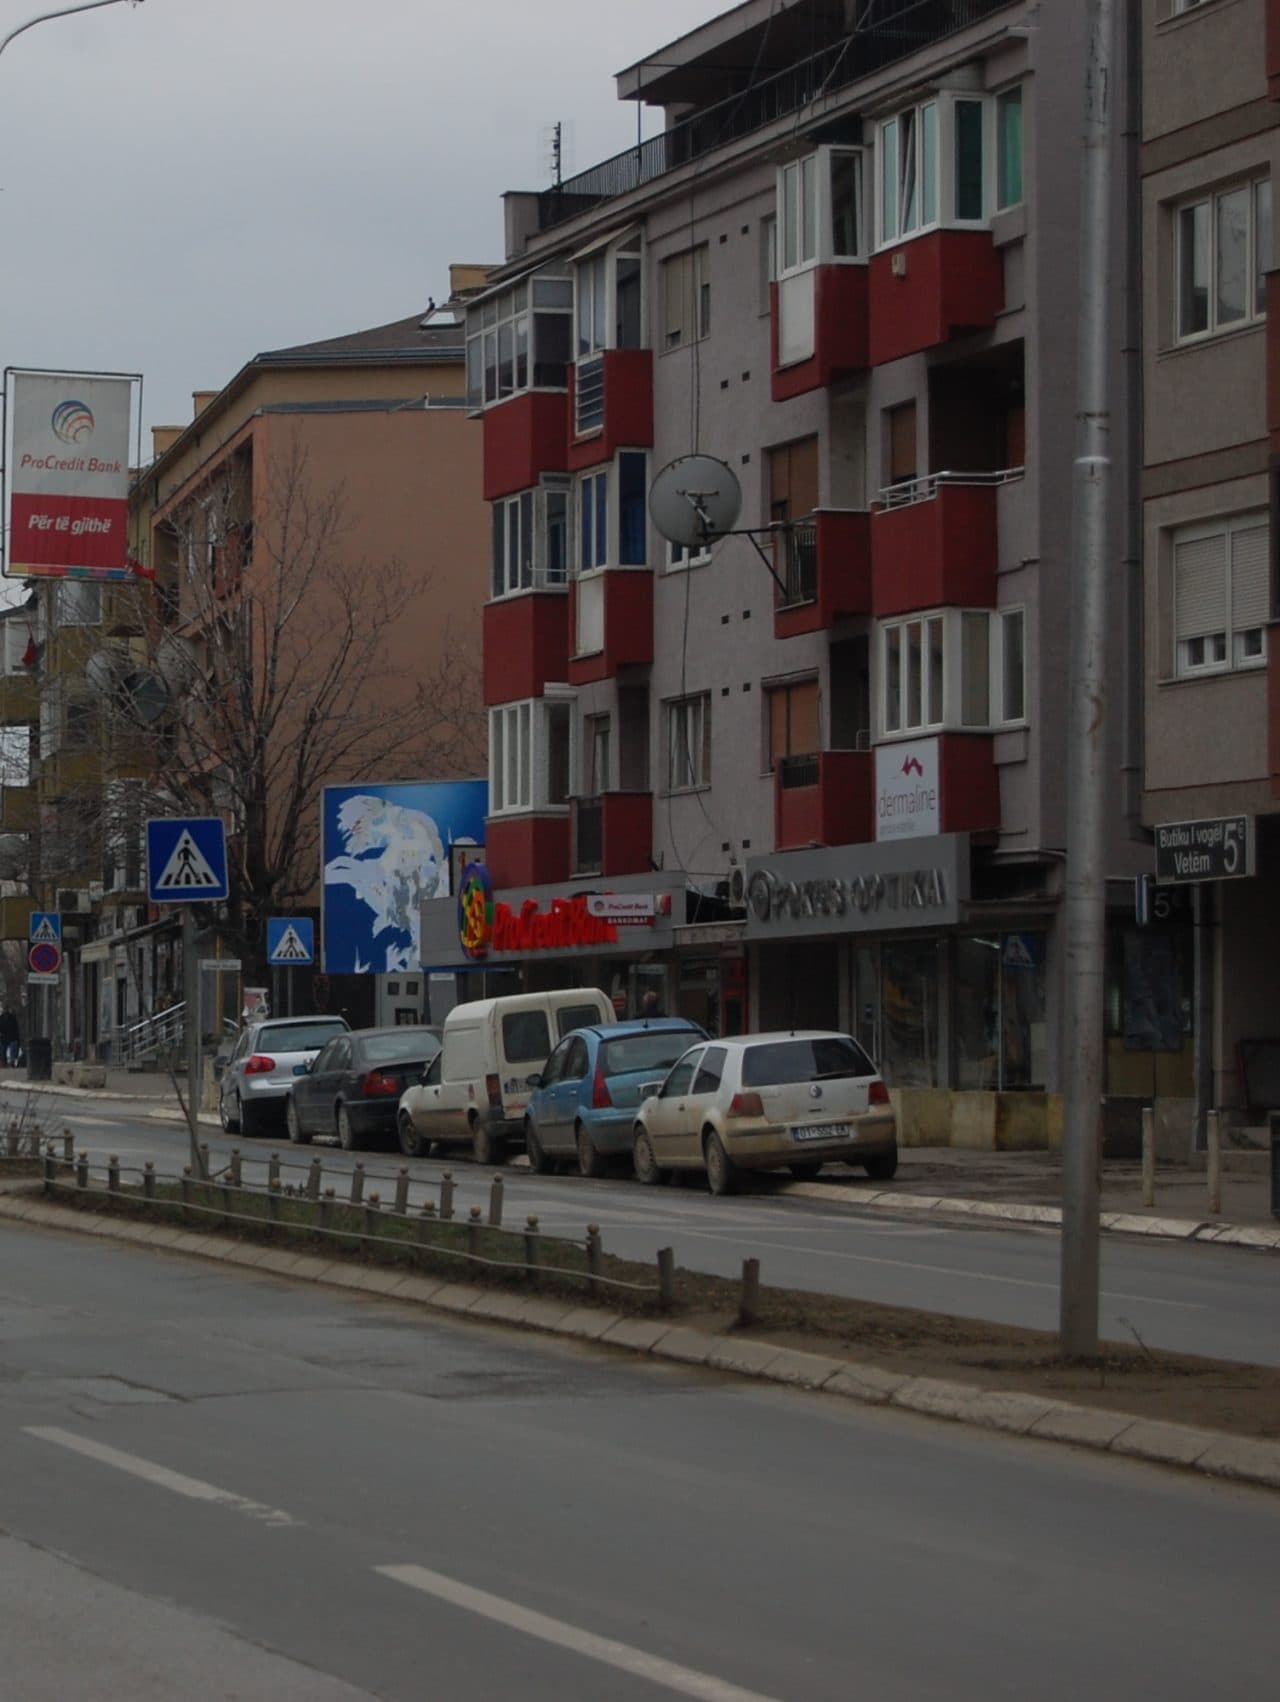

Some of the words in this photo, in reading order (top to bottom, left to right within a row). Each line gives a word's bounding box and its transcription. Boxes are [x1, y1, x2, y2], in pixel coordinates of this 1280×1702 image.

[20, 454, 84, 472] ProCredit
[87, 458, 122, 473] Bank
[28, 514, 53, 530] Për
[55, 516, 69, 531] të
[71, 517, 111, 536] gjithë
[878, 784, 936, 818] dermaline
[1160, 826, 1189, 849] Butiku
[1174, 850, 1210, 875] Vetëm
[851, 867, 949, 914] OPTIKA
